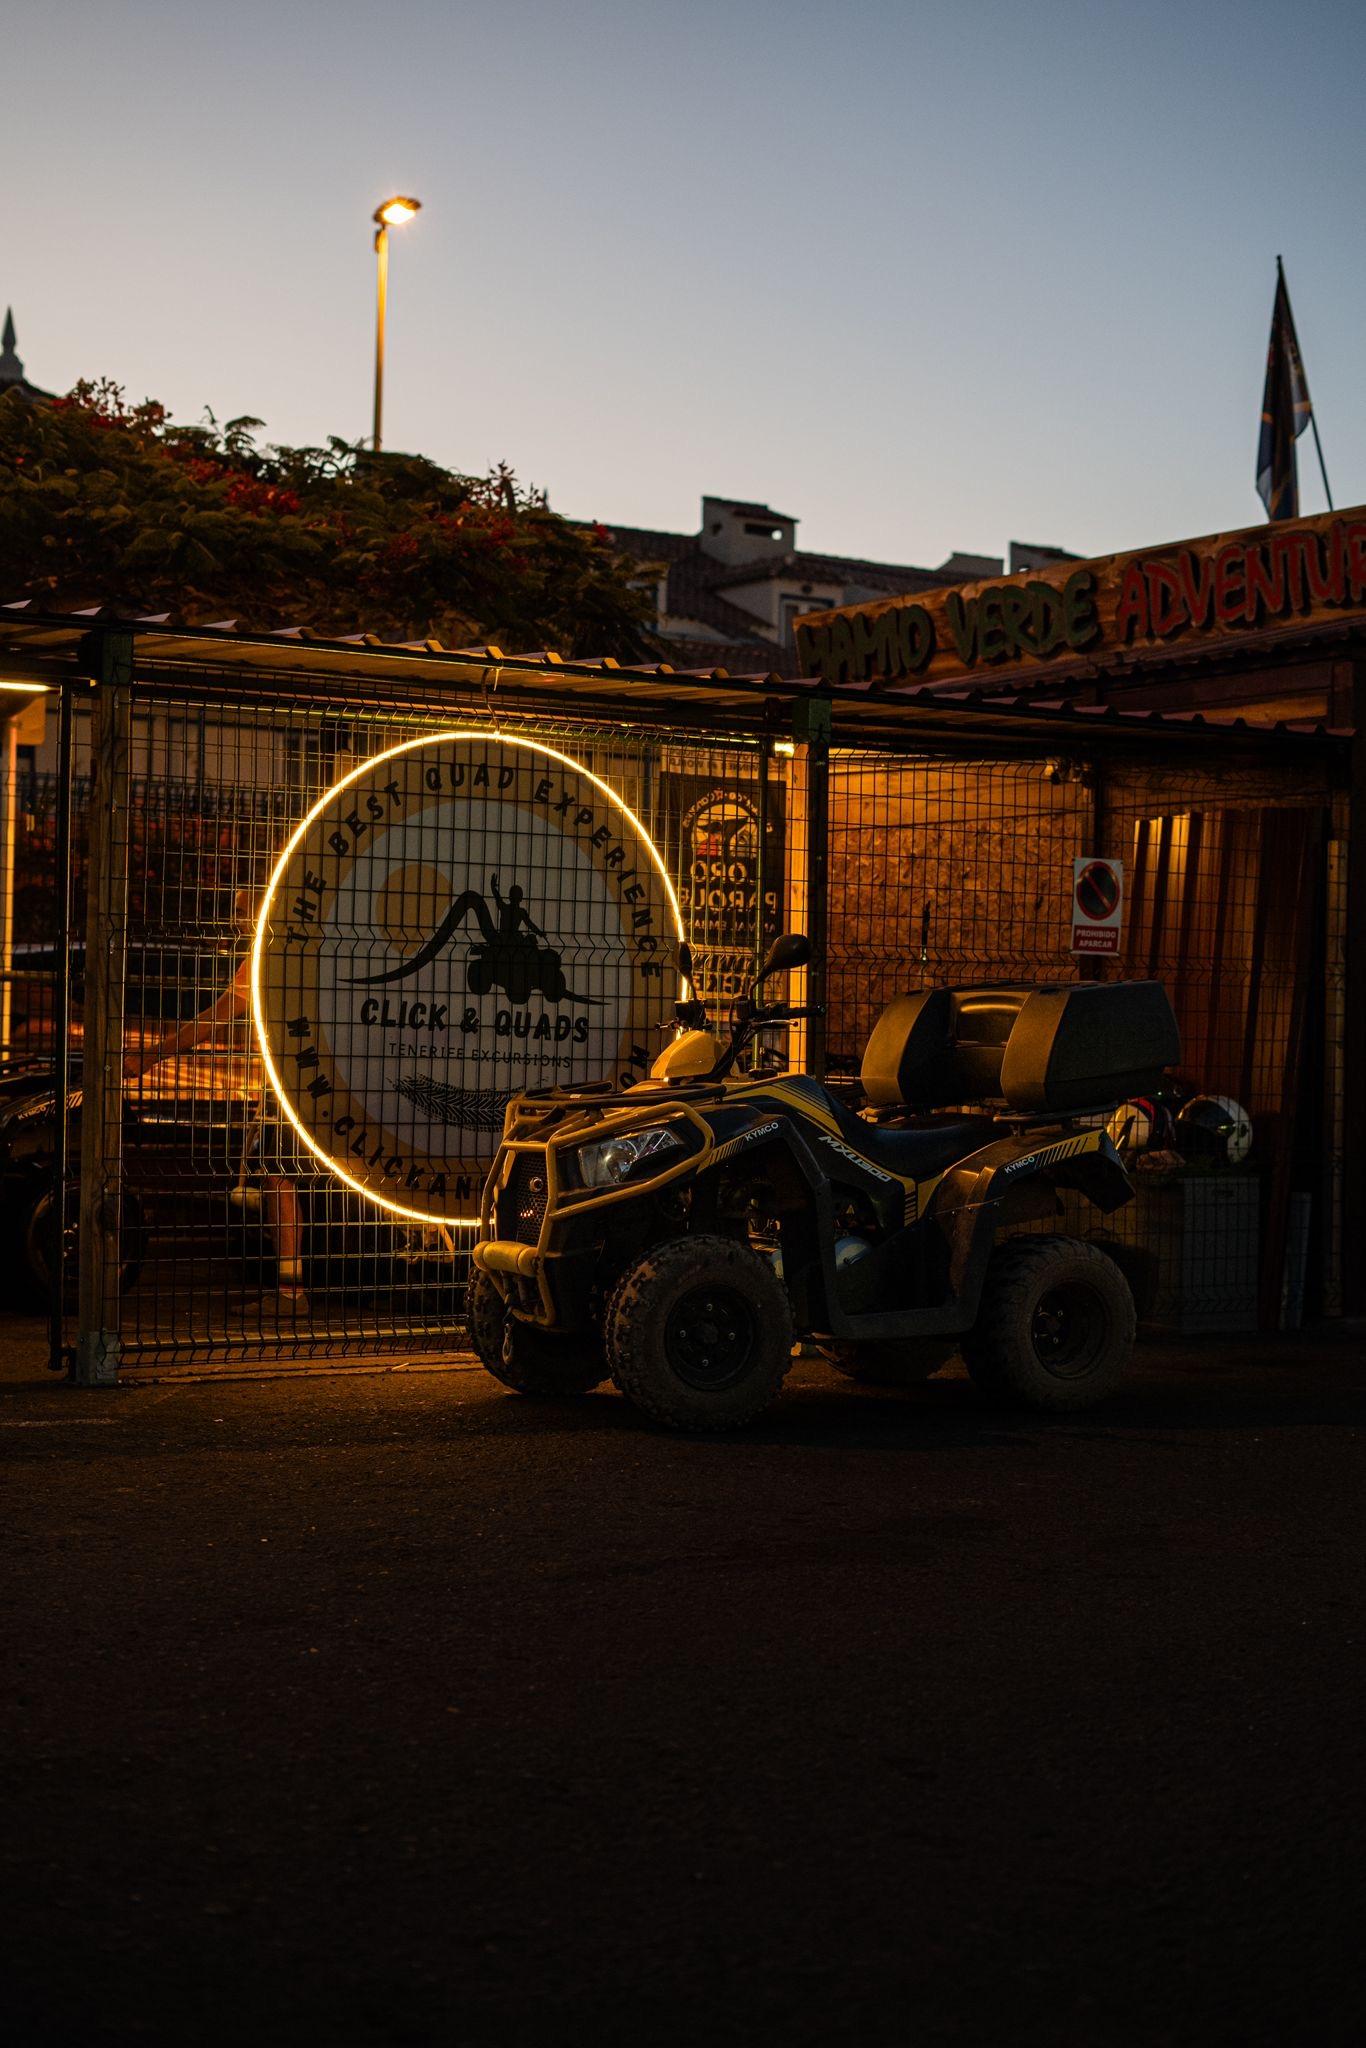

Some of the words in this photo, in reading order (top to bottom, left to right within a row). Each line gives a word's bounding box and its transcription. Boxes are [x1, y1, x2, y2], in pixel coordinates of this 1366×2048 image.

[946, 572, 1099, 667] VERDE
[286, 871, 327, 944] THE
[328, 781, 402, 856] BEST
[425, 764, 516, 791] QUAD
[534, 778, 663, 978] EXPERIENCE
[1076, 929, 1116, 938] PROHIBIDO
[361, 999, 447, 1031] CLICK
[461, 1008, 480, 1034] &
[495, 1010, 589, 1042] QUADS
[389, 1043, 465, 1060] TENERIFE
[471, 1049, 571, 1068] EXCURSIONS
[745, 1122, 779, 1142] KYMCO
[1004, 1156, 1035, 1174] KYMCO
